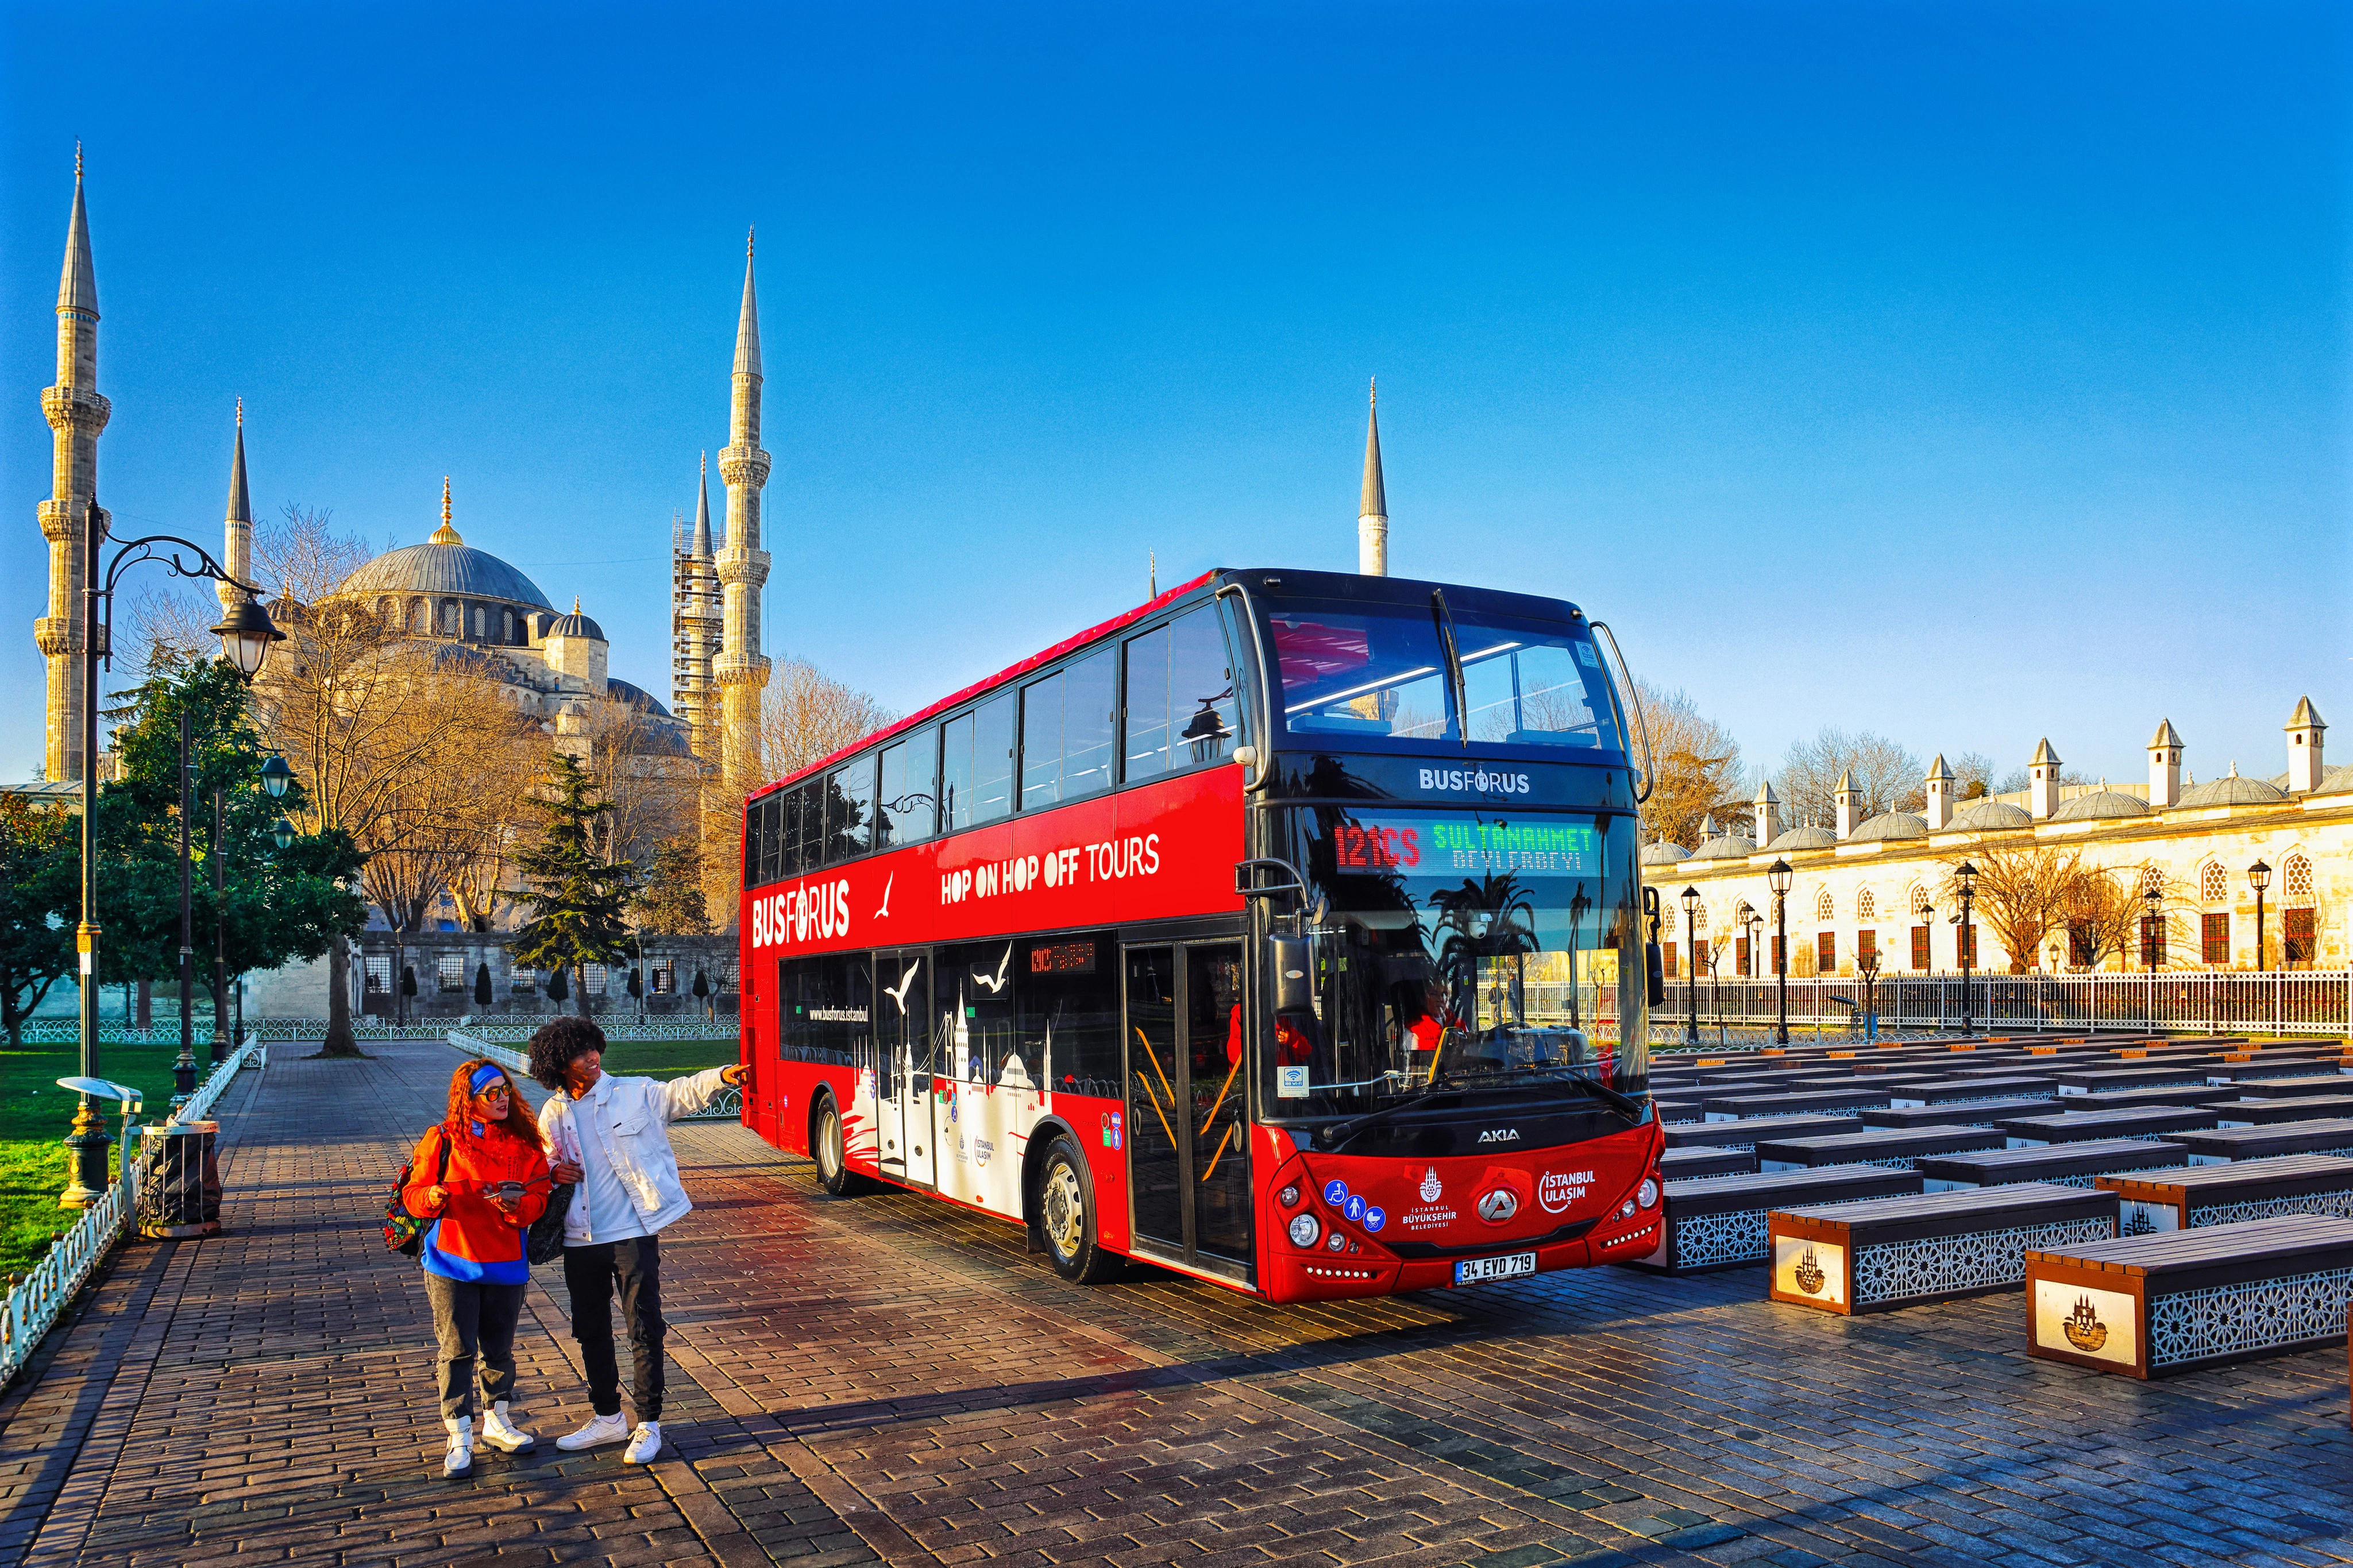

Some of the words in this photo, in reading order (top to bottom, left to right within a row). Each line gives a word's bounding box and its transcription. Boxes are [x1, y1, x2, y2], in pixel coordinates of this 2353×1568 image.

[1419, 768, 1530, 794] BUSFORUS
[1334, 827, 1420, 867] 121CS
[1433, 825, 1591, 851] SULTANAHMET
[942, 869, 972, 905] HOP
[975, 863, 998, 898] ON
[1002, 855, 1039, 894] HOP
[1044, 848, 1080, 888] OFF
[1085, 833, 1159, 882] TOURS
[753, 879, 850, 948] BUSFORUS
[809, 1005, 869, 1022] www.busforus.istanbul
[1478, 1129, 1521, 1143] AKIA
[1545, 1171, 1596, 1188] İSTANBUL
[1402, 1210, 1457, 1224] BÜYÜKŞEHİR
[1411, 1205, 1449, 1213] İSTANBUL
[1411, 1221, 1449, 1230] BELEDİYESİ
[1463, 1262, 1478, 1279] 34
[1483, 1258, 1506, 1276] EVD
[1511, 1254, 1532, 1272] 719
